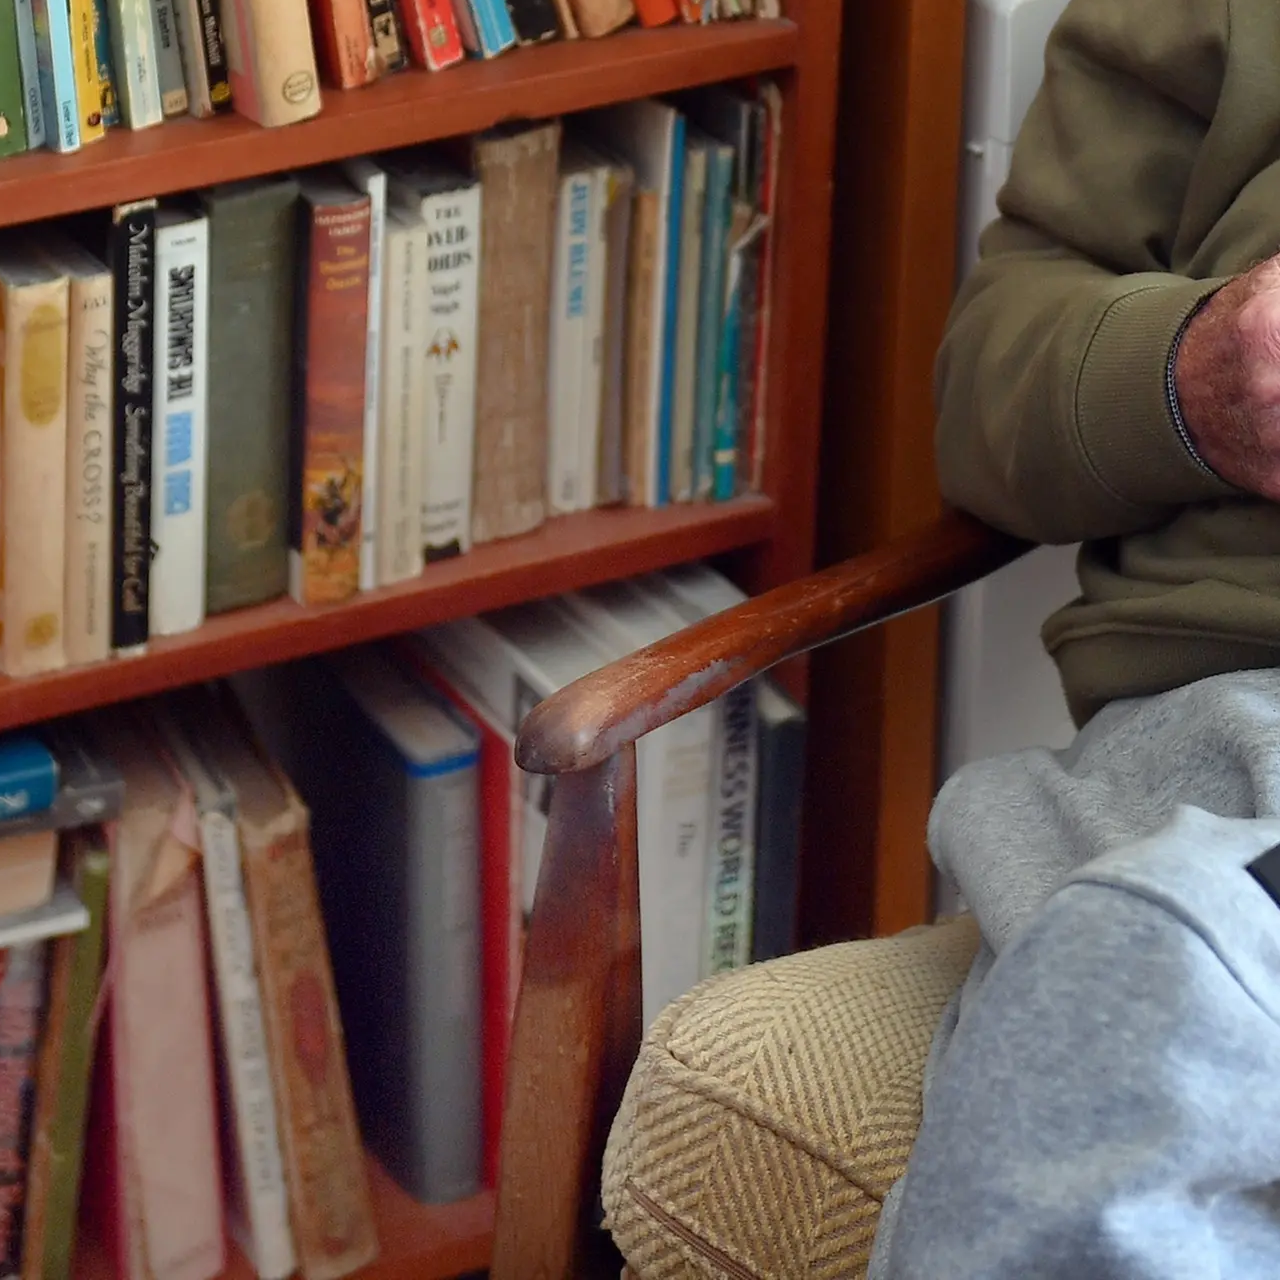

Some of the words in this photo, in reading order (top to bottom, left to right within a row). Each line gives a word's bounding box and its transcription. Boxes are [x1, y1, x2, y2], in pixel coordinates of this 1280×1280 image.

[127, 222, 149, 300] Malcolm
[83, 393, 106, 422] the
[76, 429, 104, 525] CROSS?
